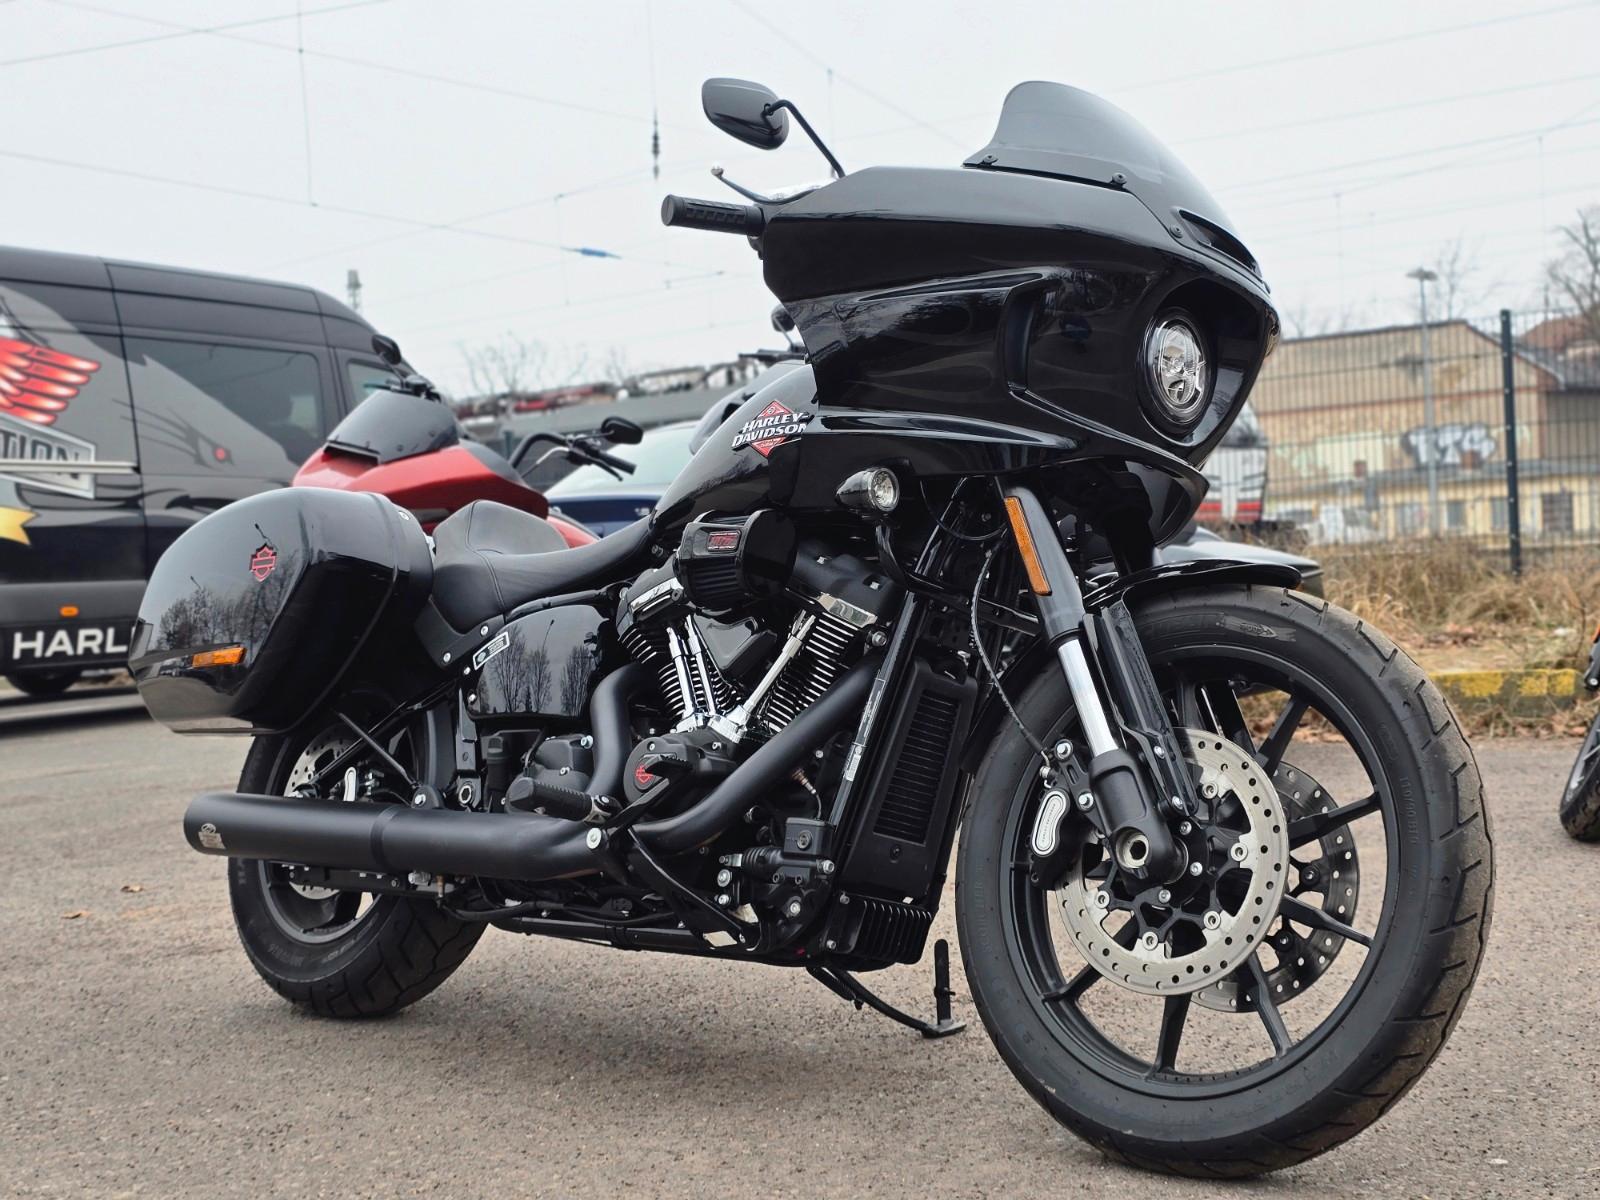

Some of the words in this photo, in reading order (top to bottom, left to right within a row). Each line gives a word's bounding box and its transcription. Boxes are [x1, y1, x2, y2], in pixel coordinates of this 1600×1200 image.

[731, 423, 807, 447] DAVIDSON
[742, 412, 809, 434] HARLEY-
[12, 626, 136, 660] HARL
